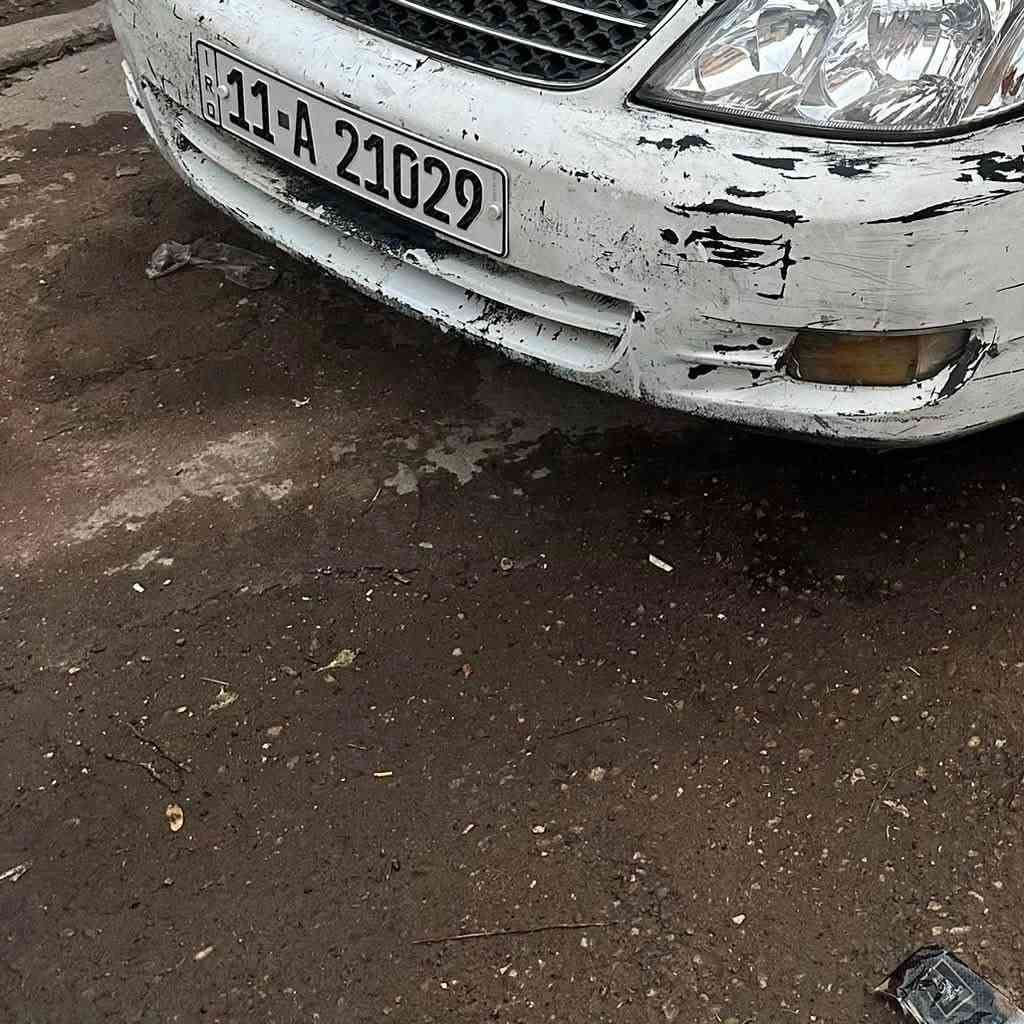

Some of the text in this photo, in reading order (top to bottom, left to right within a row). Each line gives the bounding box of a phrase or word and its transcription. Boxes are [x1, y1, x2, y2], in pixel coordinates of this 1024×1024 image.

[204, 49, 216, 121] IRQ
[227, 68, 482, 231] 11-A 21029
